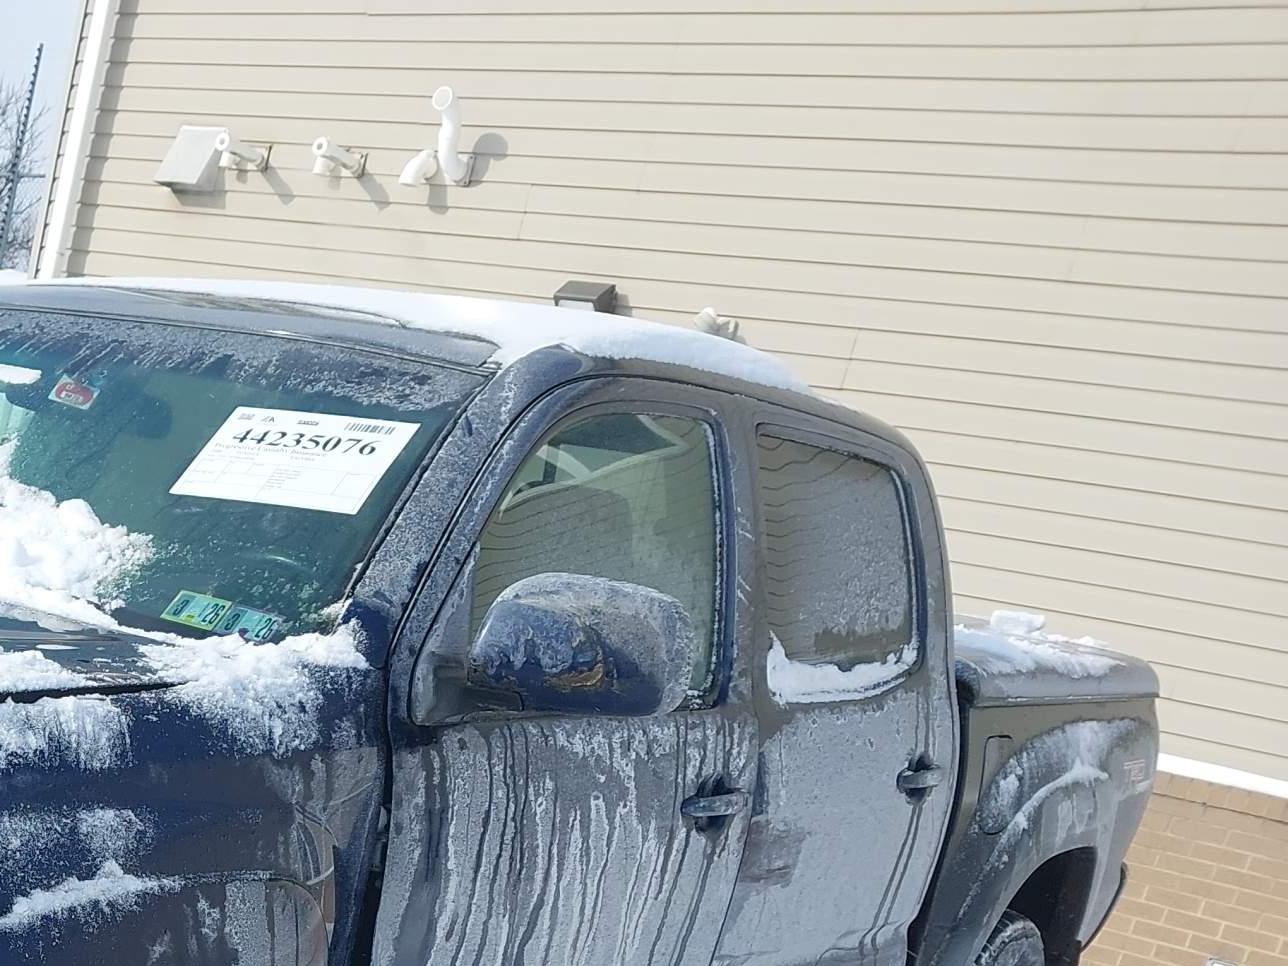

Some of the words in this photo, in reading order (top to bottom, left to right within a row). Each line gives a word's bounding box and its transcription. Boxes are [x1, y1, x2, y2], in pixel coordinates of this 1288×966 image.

[232, 428, 383, 456] 44235076
[173, 599, 191, 616] 3
[201, 603, 226, 625] 26
[224, 613, 241, 631] 3
